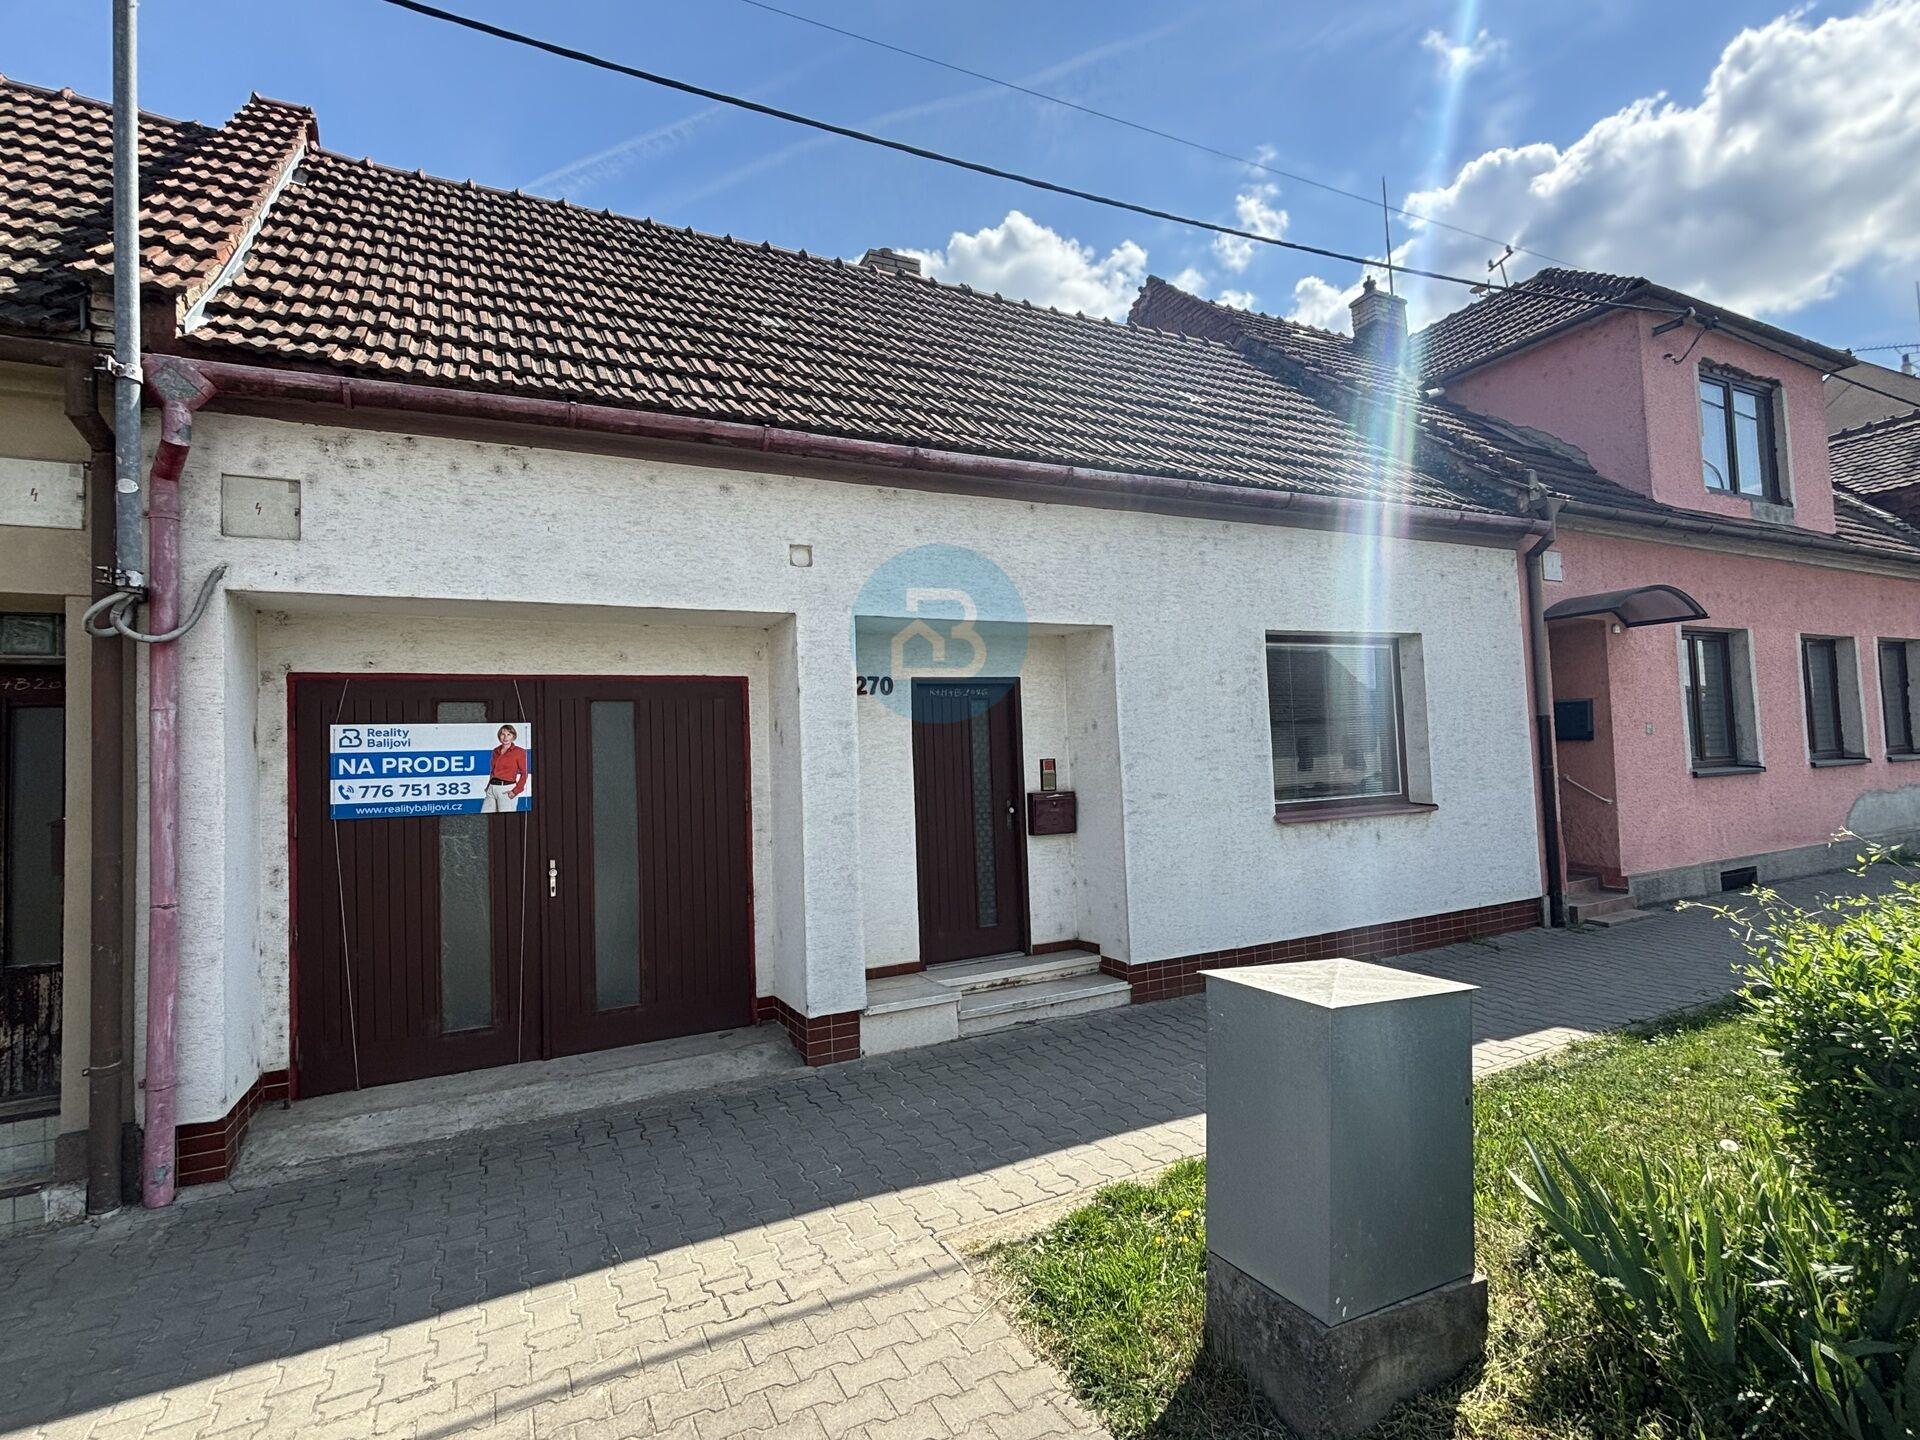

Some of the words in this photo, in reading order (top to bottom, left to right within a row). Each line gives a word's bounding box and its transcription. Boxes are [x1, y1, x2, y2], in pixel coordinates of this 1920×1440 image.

[856, 676, 894, 696] 270
[367, 728, 410, 739] Reality
[367, 738, 411, 750] Balijovi
[338, 758, 375, 775] NA
[382, 756, 476, 774] PRODEJ
[358, 785, 394, 799] 776
[400, 784, 430, 797] 751
[436, 782, 471, 796] 383
[355, 803, 463, 815] www.realitybalijovi.cz
